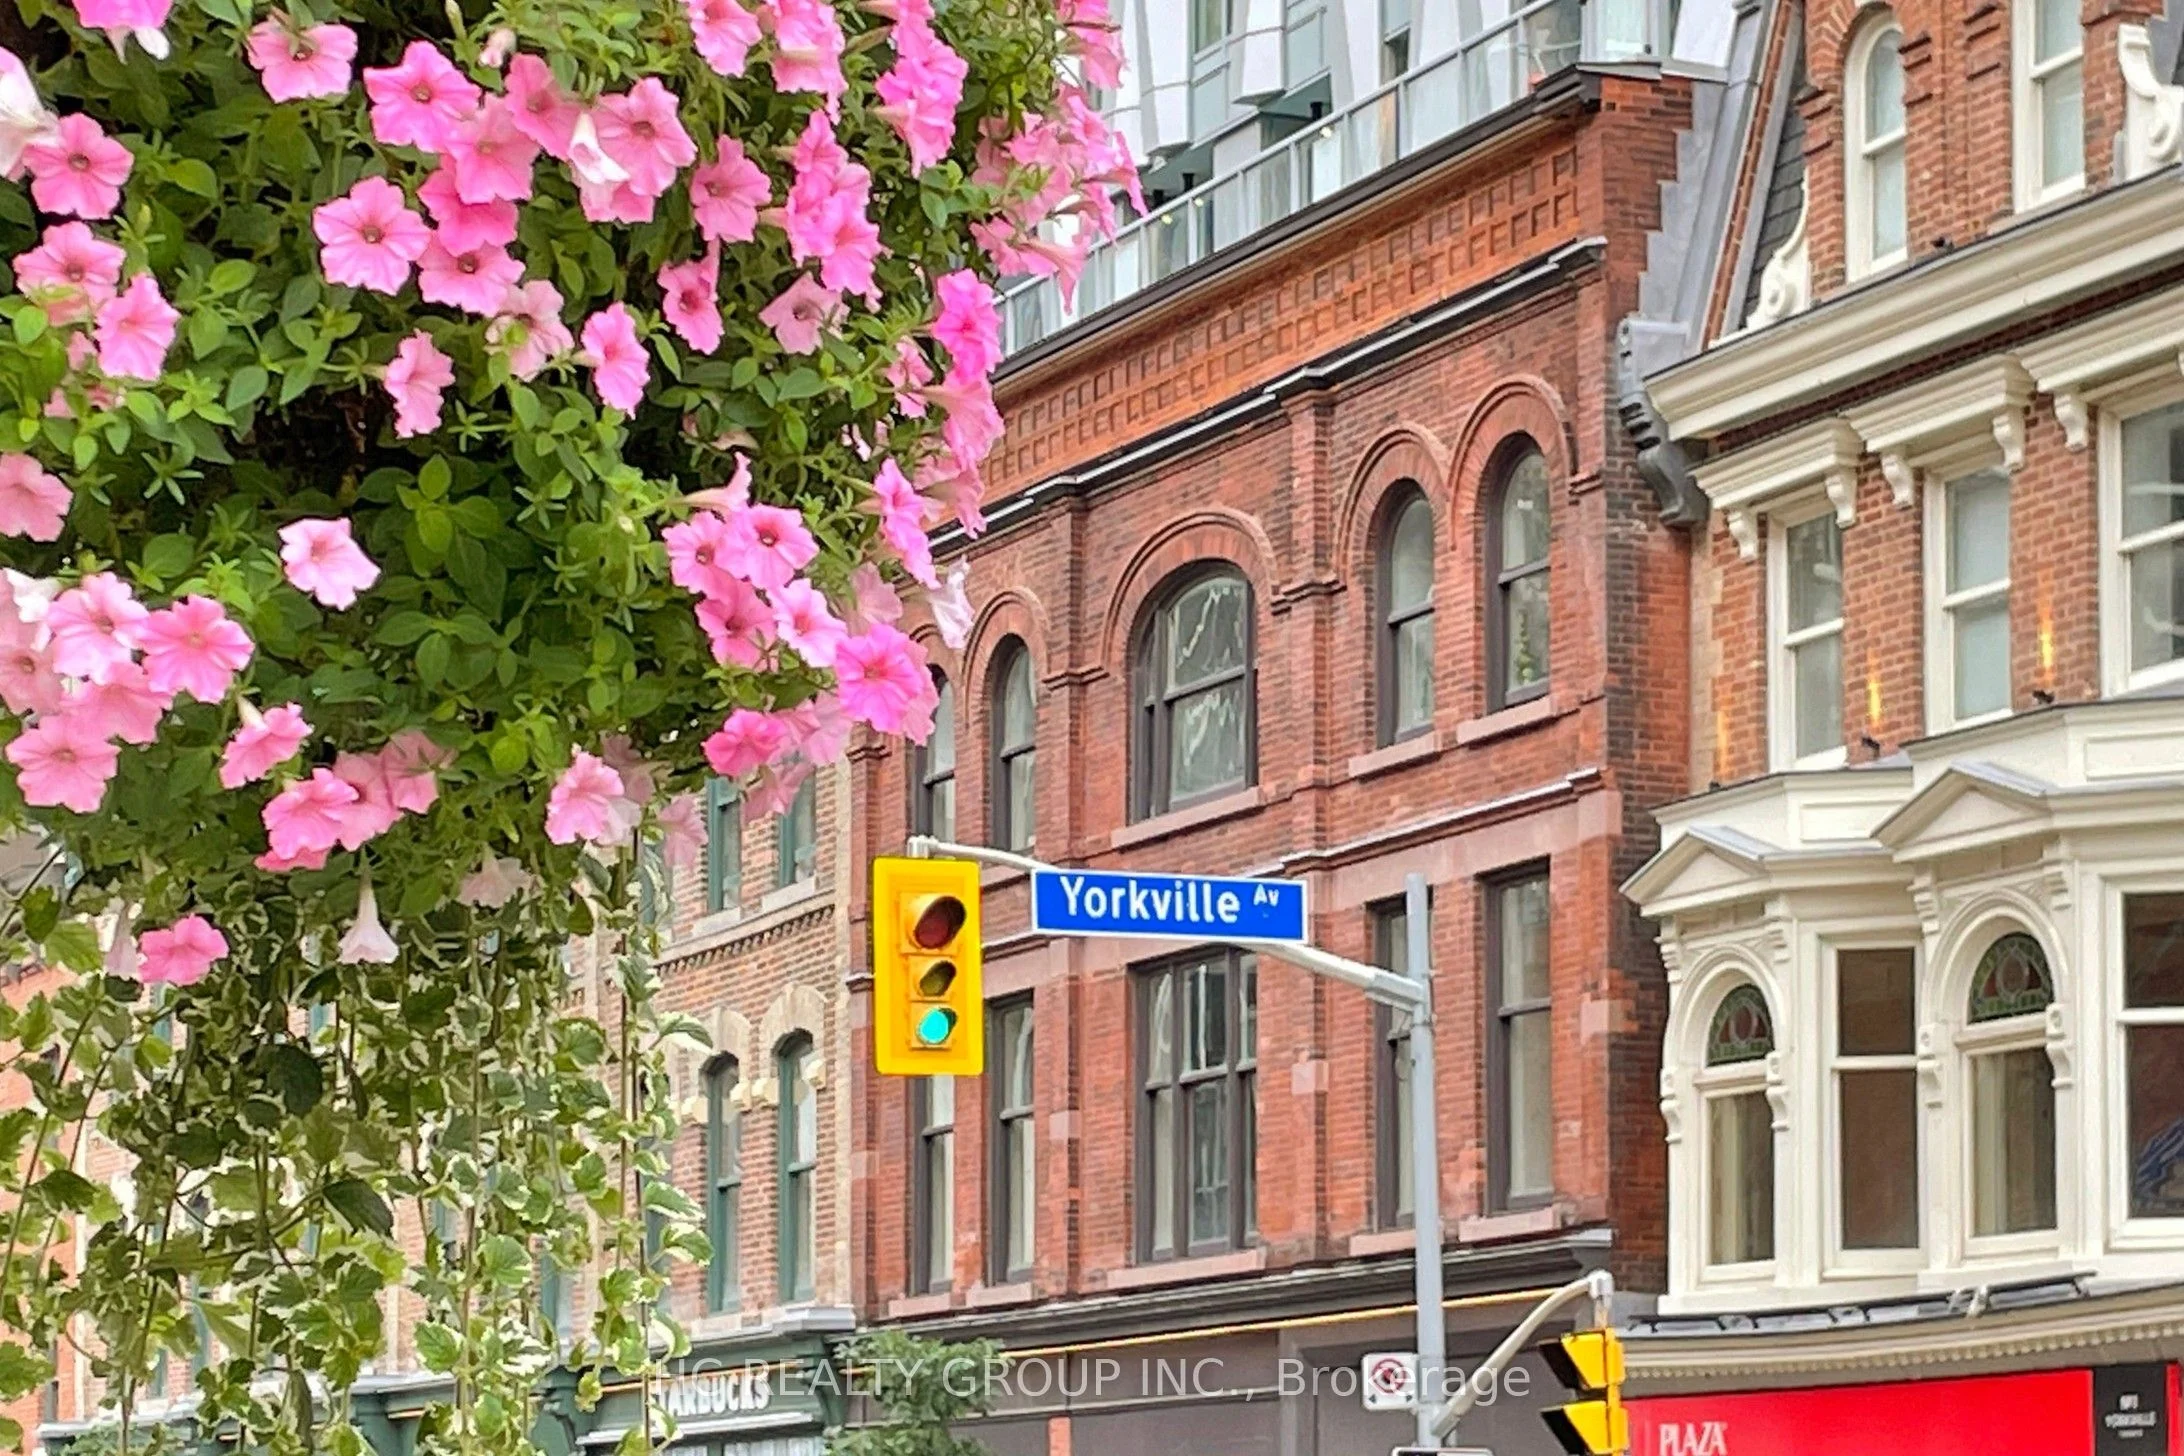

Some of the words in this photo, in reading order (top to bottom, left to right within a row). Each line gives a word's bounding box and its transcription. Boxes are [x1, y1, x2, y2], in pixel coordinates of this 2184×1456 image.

[1059, 876, 1241, 924] Yorkville
[1252, 883, 1280, 907] Av
[648, 1372, 770, 1417] TARBUCKS
[1659, 1421, 1729, 1456] PLAZA
